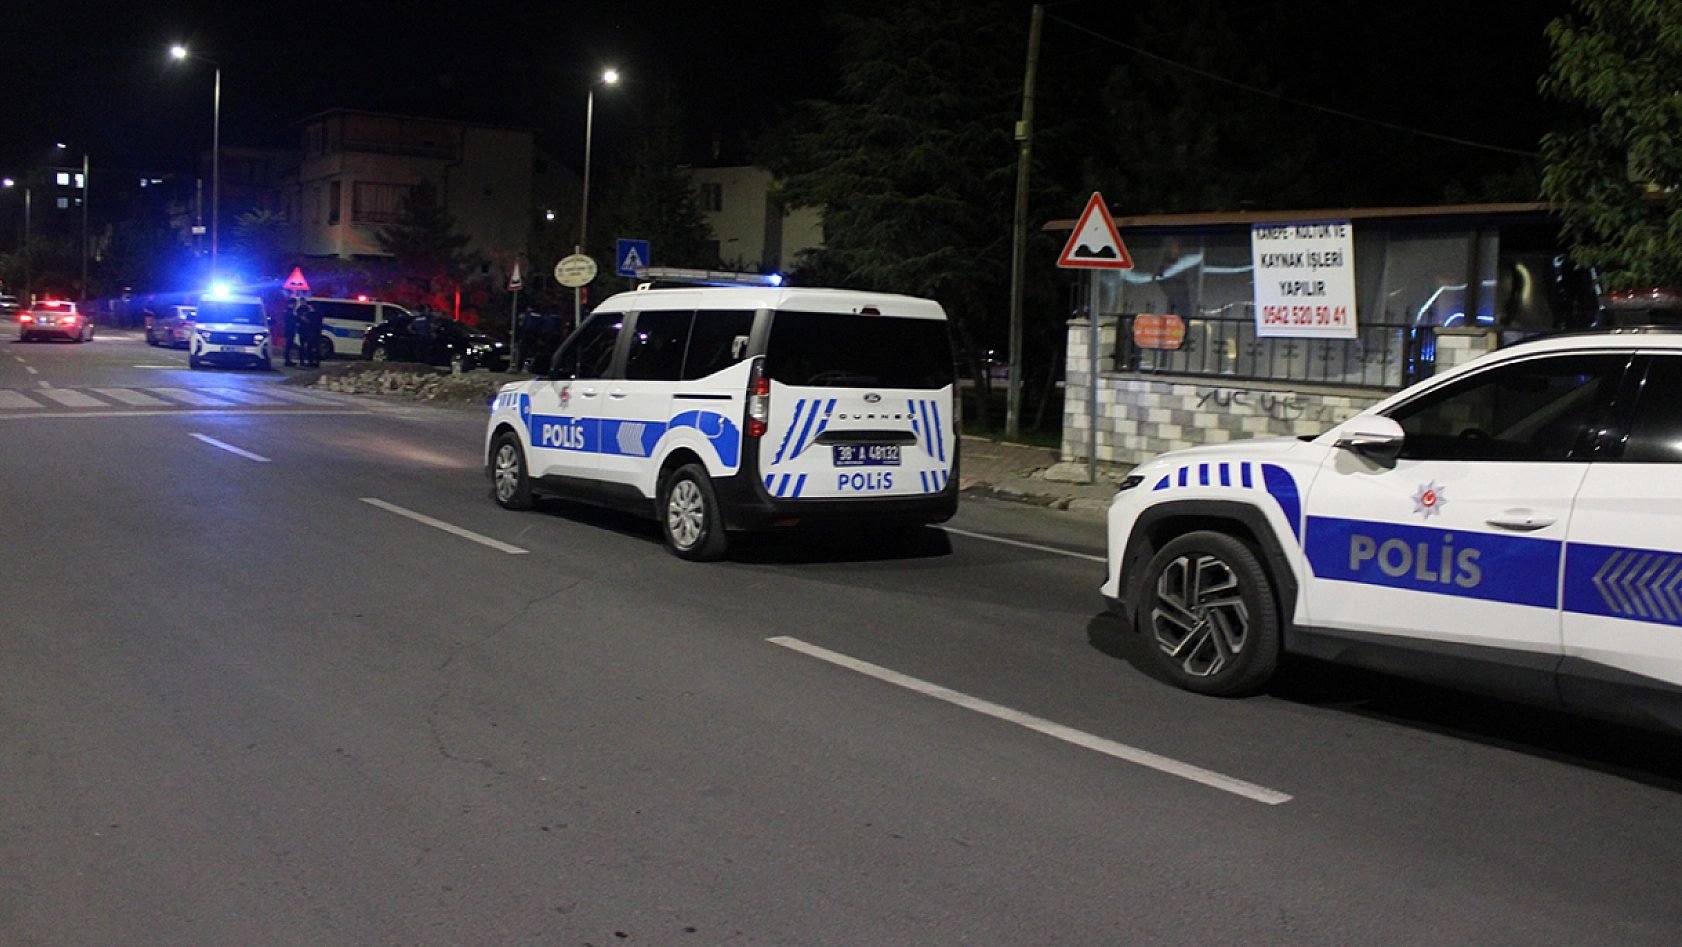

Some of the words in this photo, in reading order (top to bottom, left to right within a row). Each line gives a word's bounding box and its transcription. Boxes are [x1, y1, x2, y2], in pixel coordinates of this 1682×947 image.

[1260, 252, 1304, 268] KAYNAK
[1307, 247, 1343, 272] İŞLERİ
[1279, 280, 1326, 297] YAPILIR
[1263, 304, 1290, 326] 0542
[1292, 304, 1313, 326] 520
[1316, 304, 1330, 326] 50
[1333, 304, 1347, 326] 41
